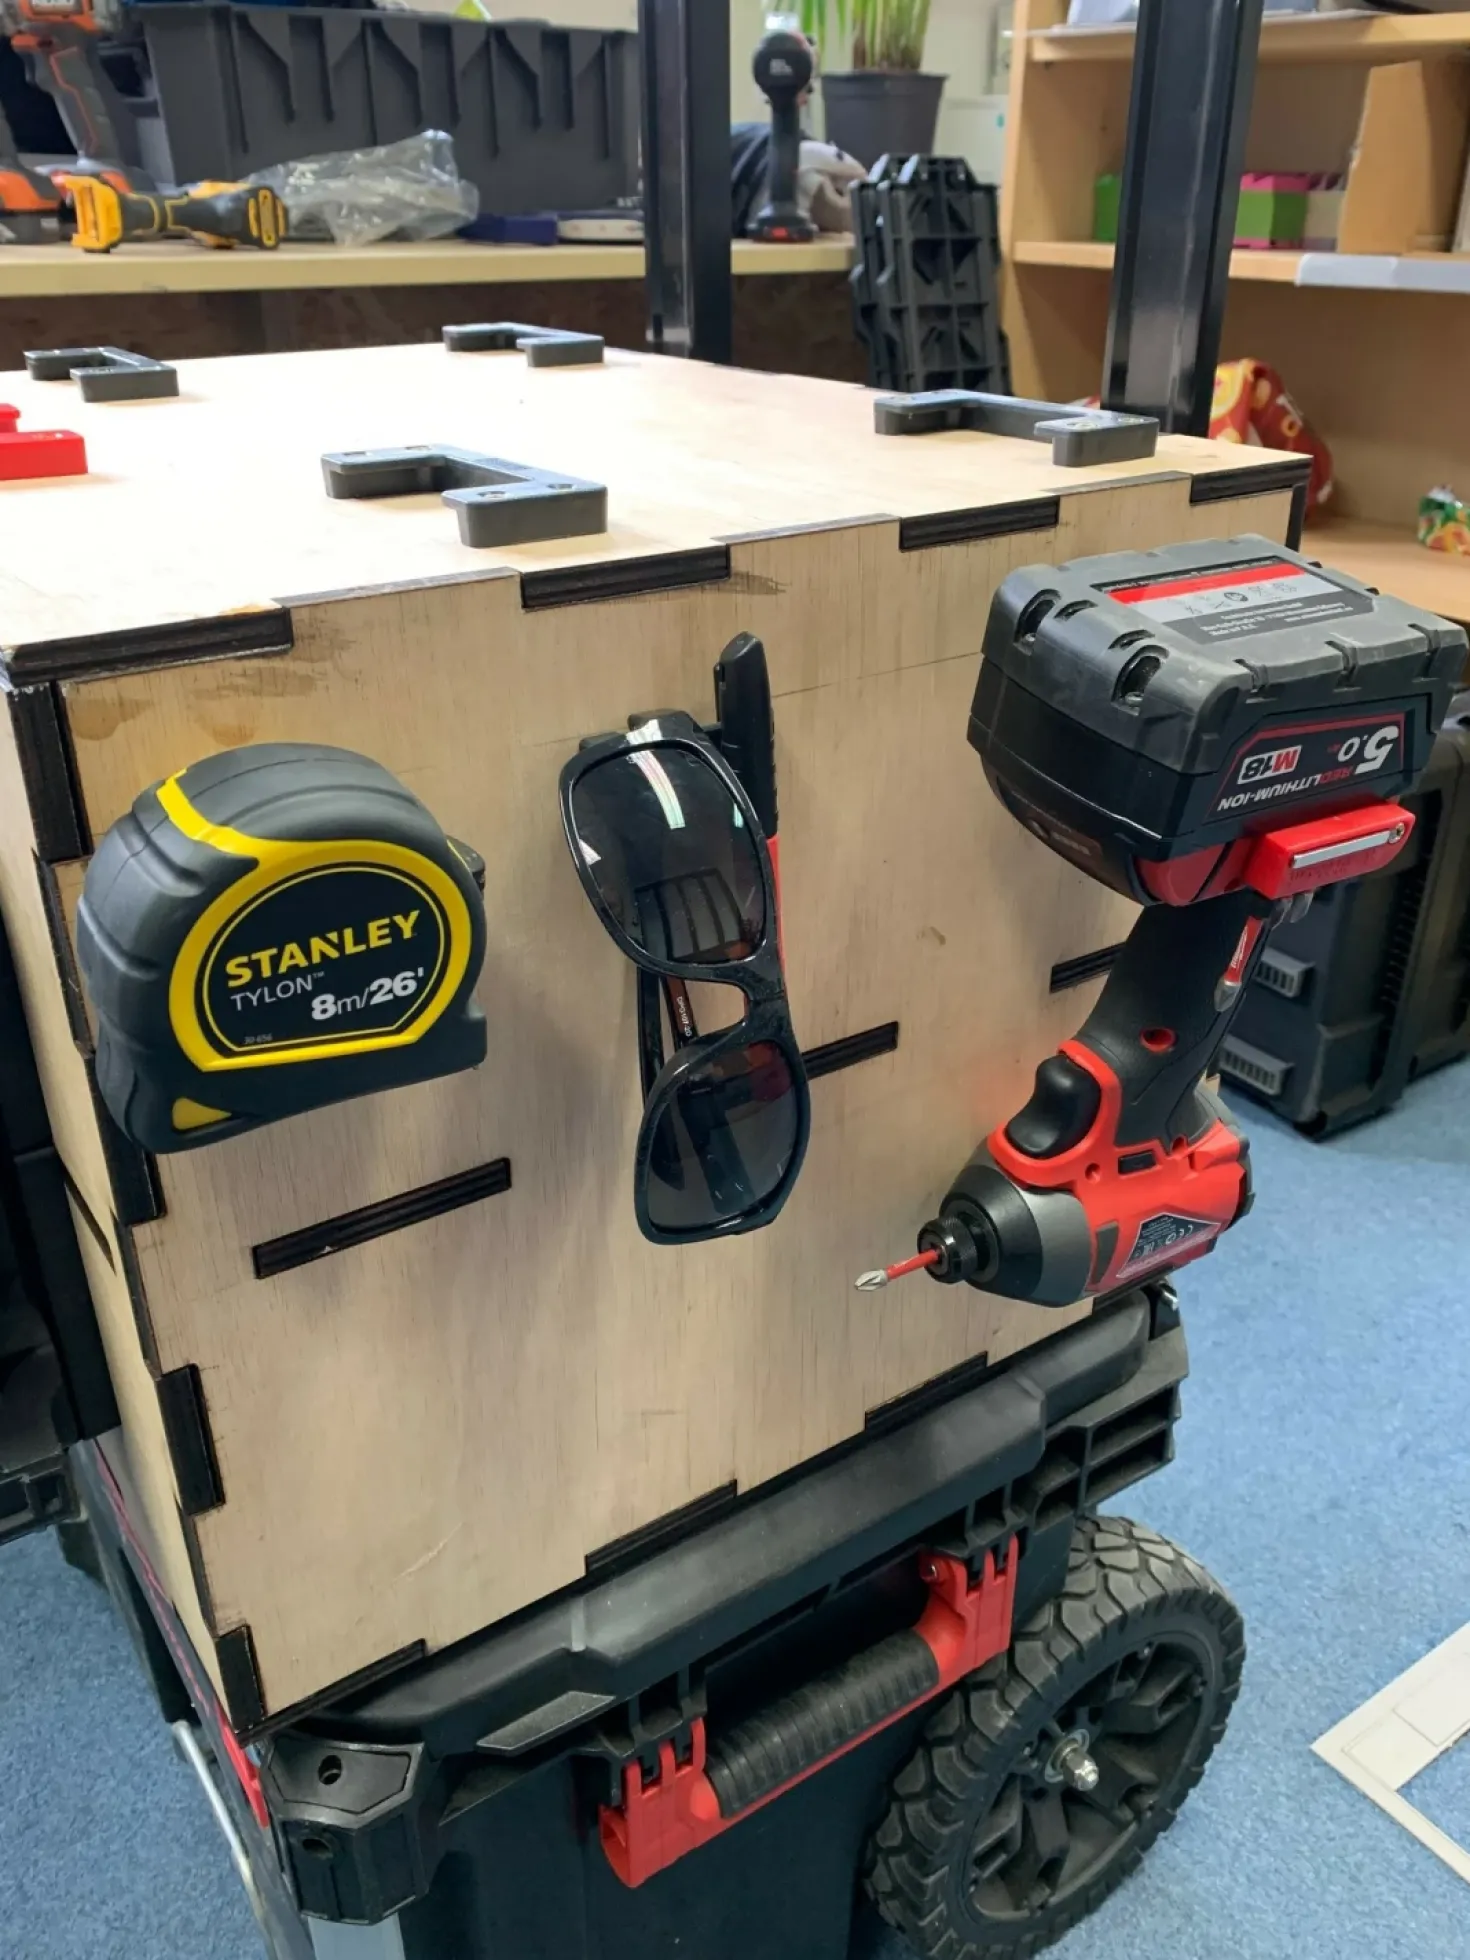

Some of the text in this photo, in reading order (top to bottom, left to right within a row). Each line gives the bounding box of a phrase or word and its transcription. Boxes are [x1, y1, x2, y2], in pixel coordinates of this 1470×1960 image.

[1241, 750, 1298, 780] M18
[1337, 725, 1399, 774] 5.0
[1217, 767, 1353, 810] REDLITHIUM-ION
[225, 911, 420, 987] STANLEY
[311, 968, 425, 1020] 8m/26'
